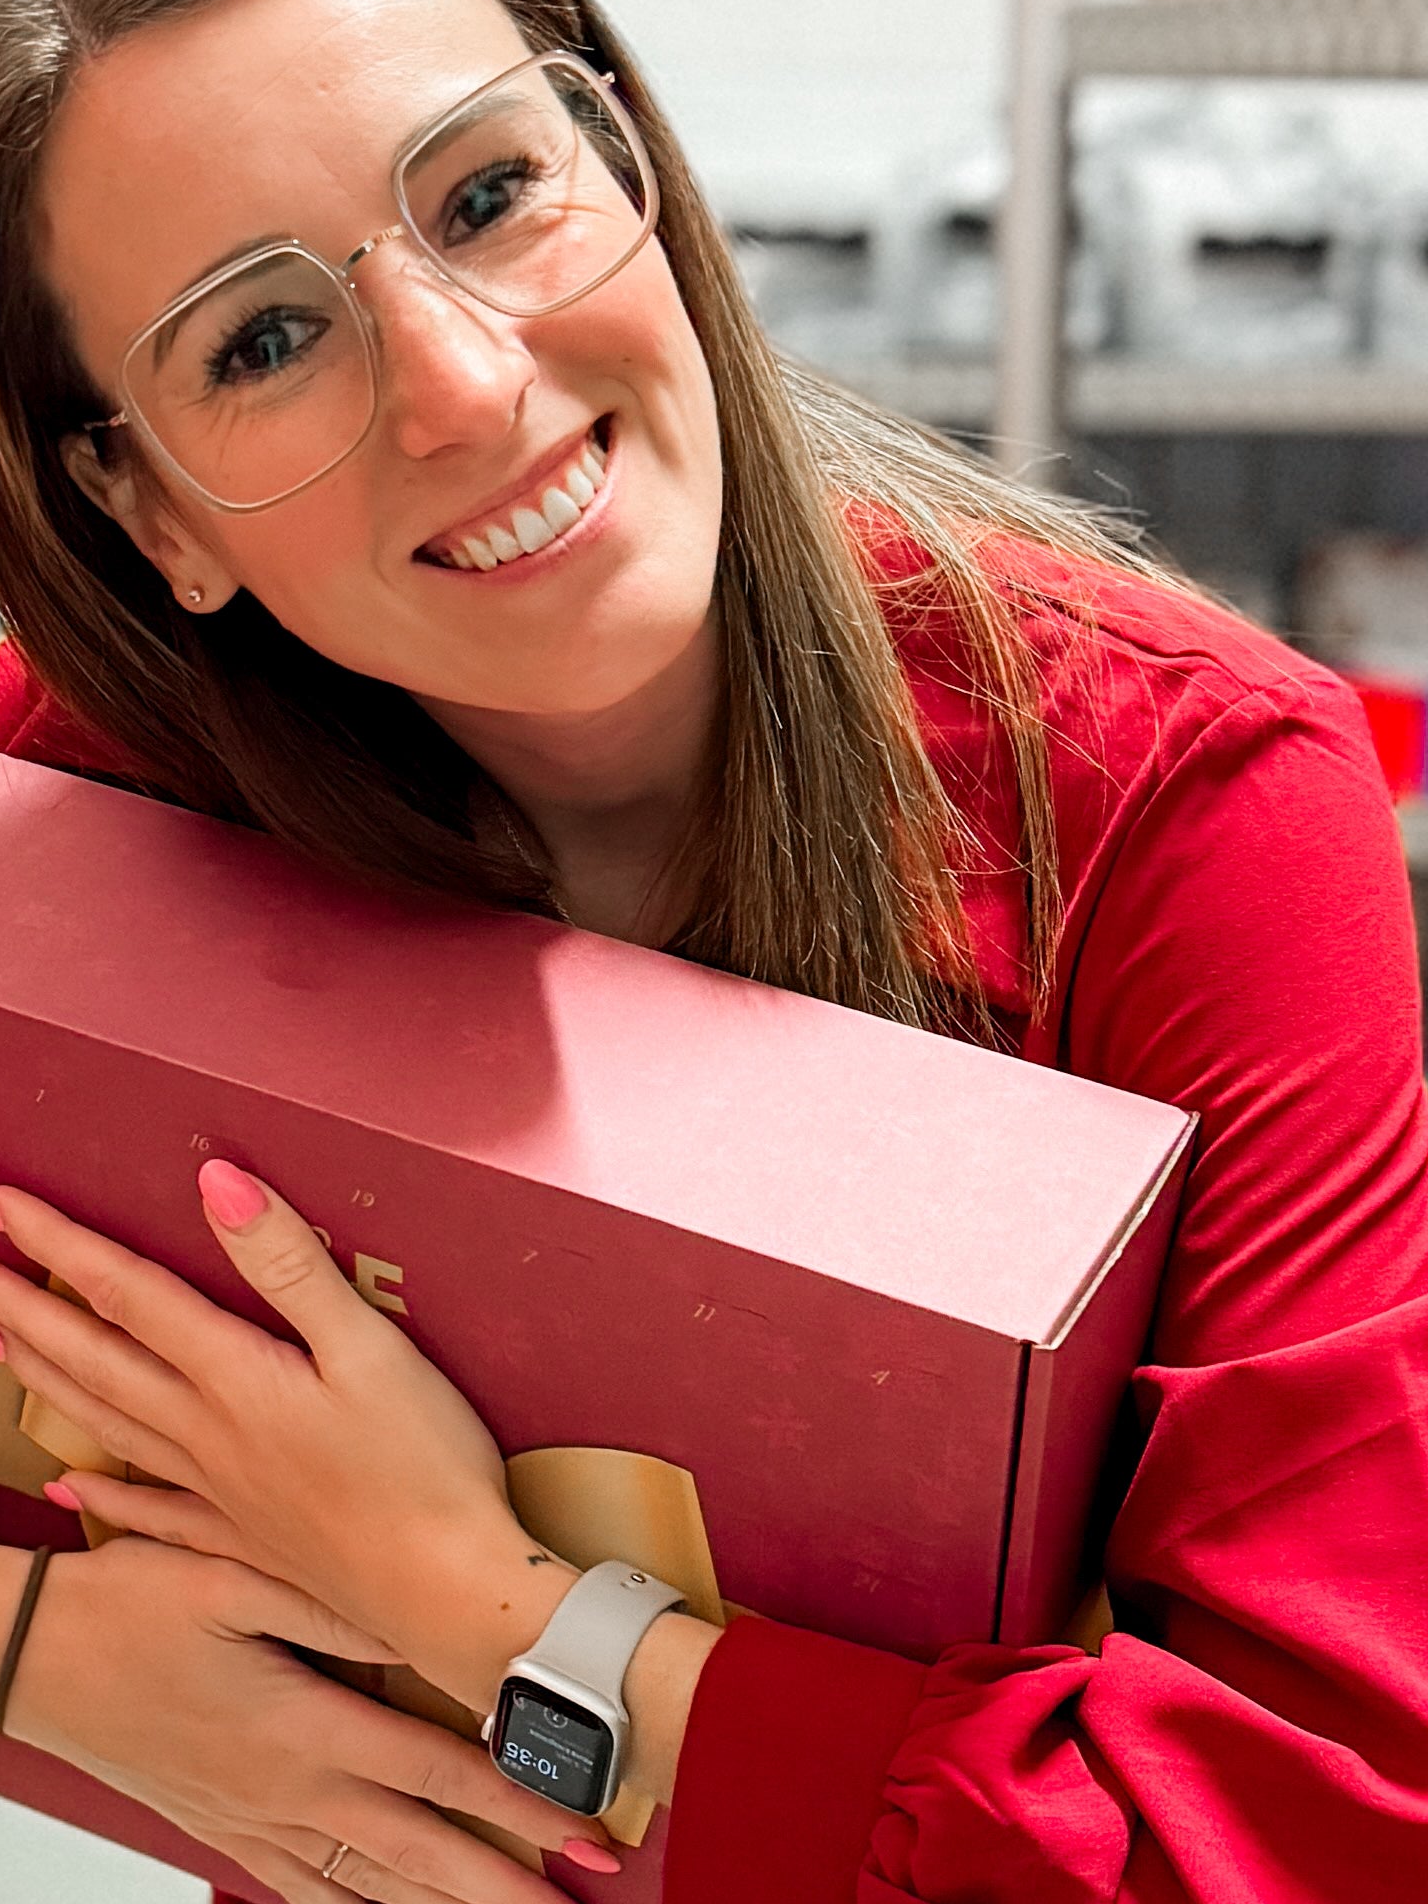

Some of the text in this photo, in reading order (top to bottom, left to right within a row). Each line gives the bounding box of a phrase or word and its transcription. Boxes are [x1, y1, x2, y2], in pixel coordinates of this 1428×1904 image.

[189, 1133, 211, 1153] 16
[351, 1189, 376, 1208] 19
[504, 1741, 561, 1780] 10:35
